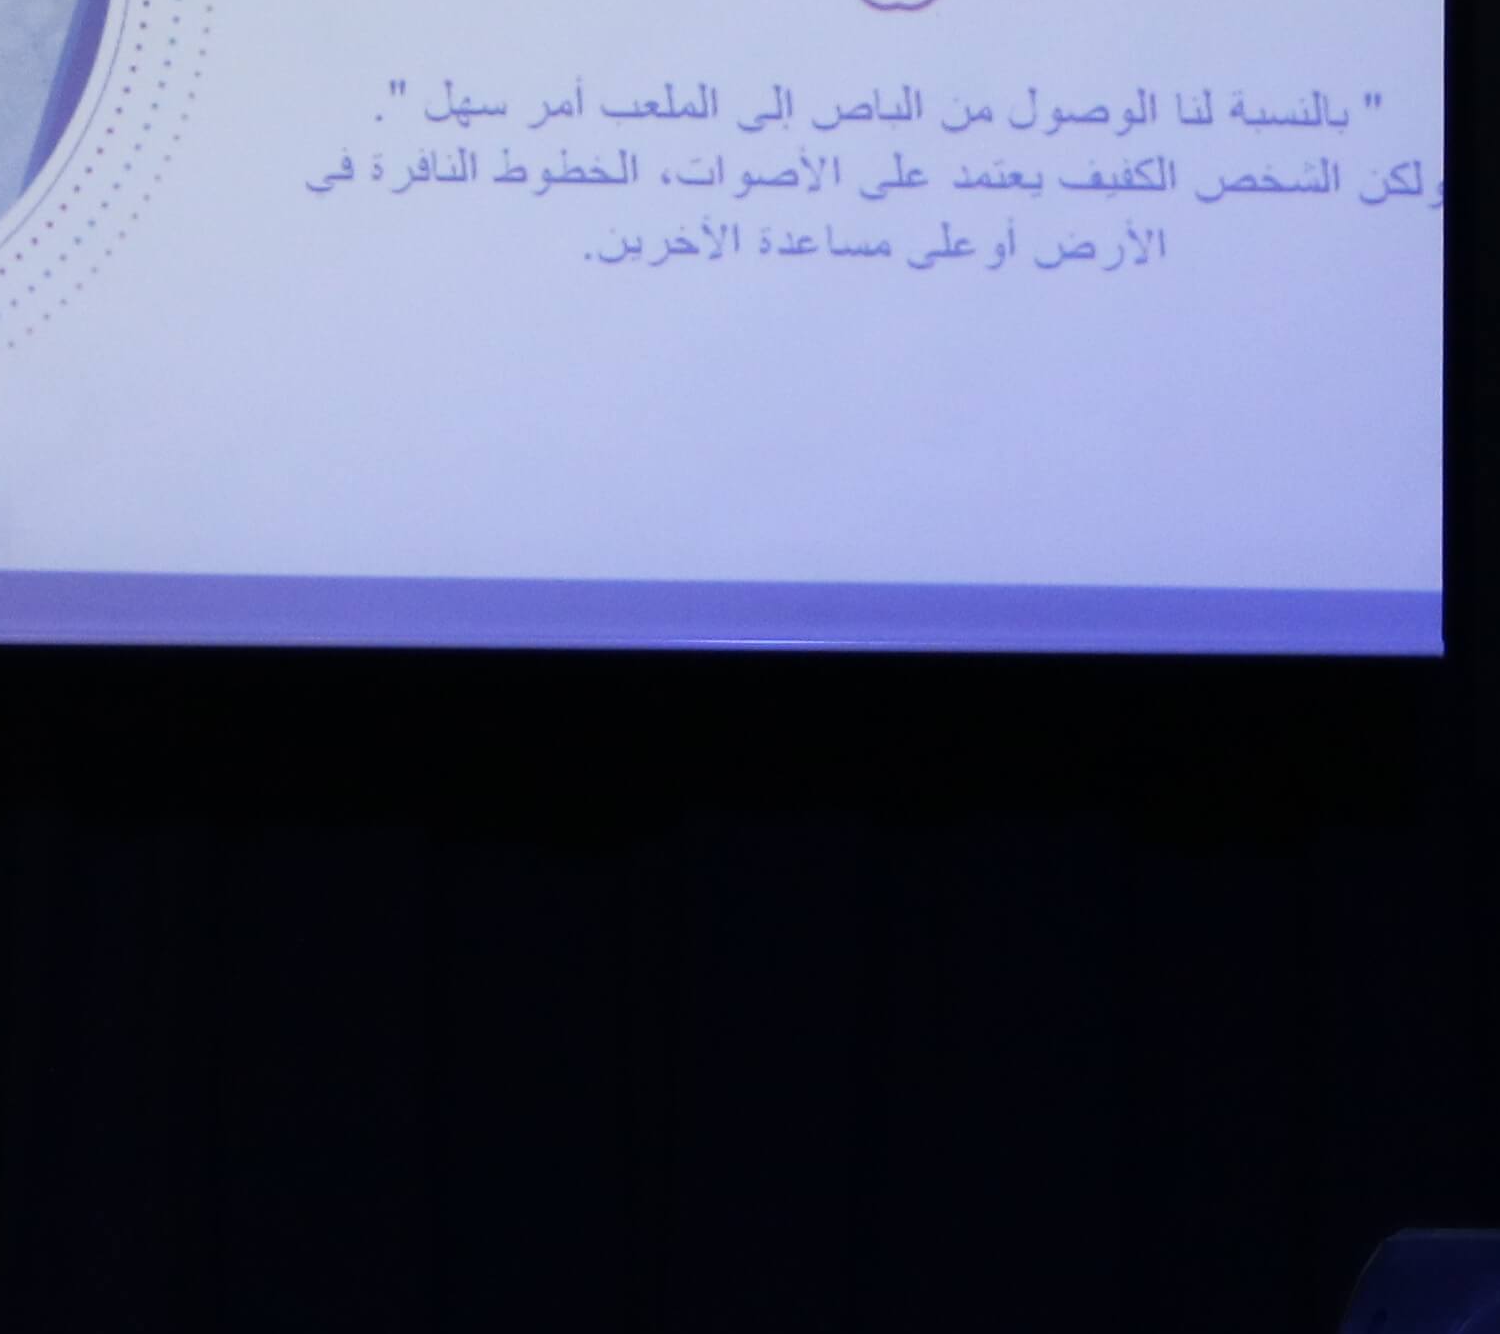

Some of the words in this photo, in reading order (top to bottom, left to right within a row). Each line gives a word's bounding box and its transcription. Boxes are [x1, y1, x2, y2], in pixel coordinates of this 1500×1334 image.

[424, 78, 507, 129] سهل
[527, 75, 583, 130] أمر
[600, 82, 718, 120] الملعب
[812, 84, 923, 133] الباص
[941, 99, 994, 134] من
[1008, 86, 1157, 137] الوصول
[1176, 88, 1214, 126] لنا
[1229, 90, 1349, 134] بالنسبة
[371, 147, 477, 195] النافرة
[493, 148, 639, 197] الخطوط
[952, 160, 1044, 198] يعتمد
[1059, 155, 1176, 198] الكفيف
[1195, 157, 1340, 205] الشخص
[759, 225, 892, 258] مساعدة
[1034, 221, 1166, 272] الأرض
